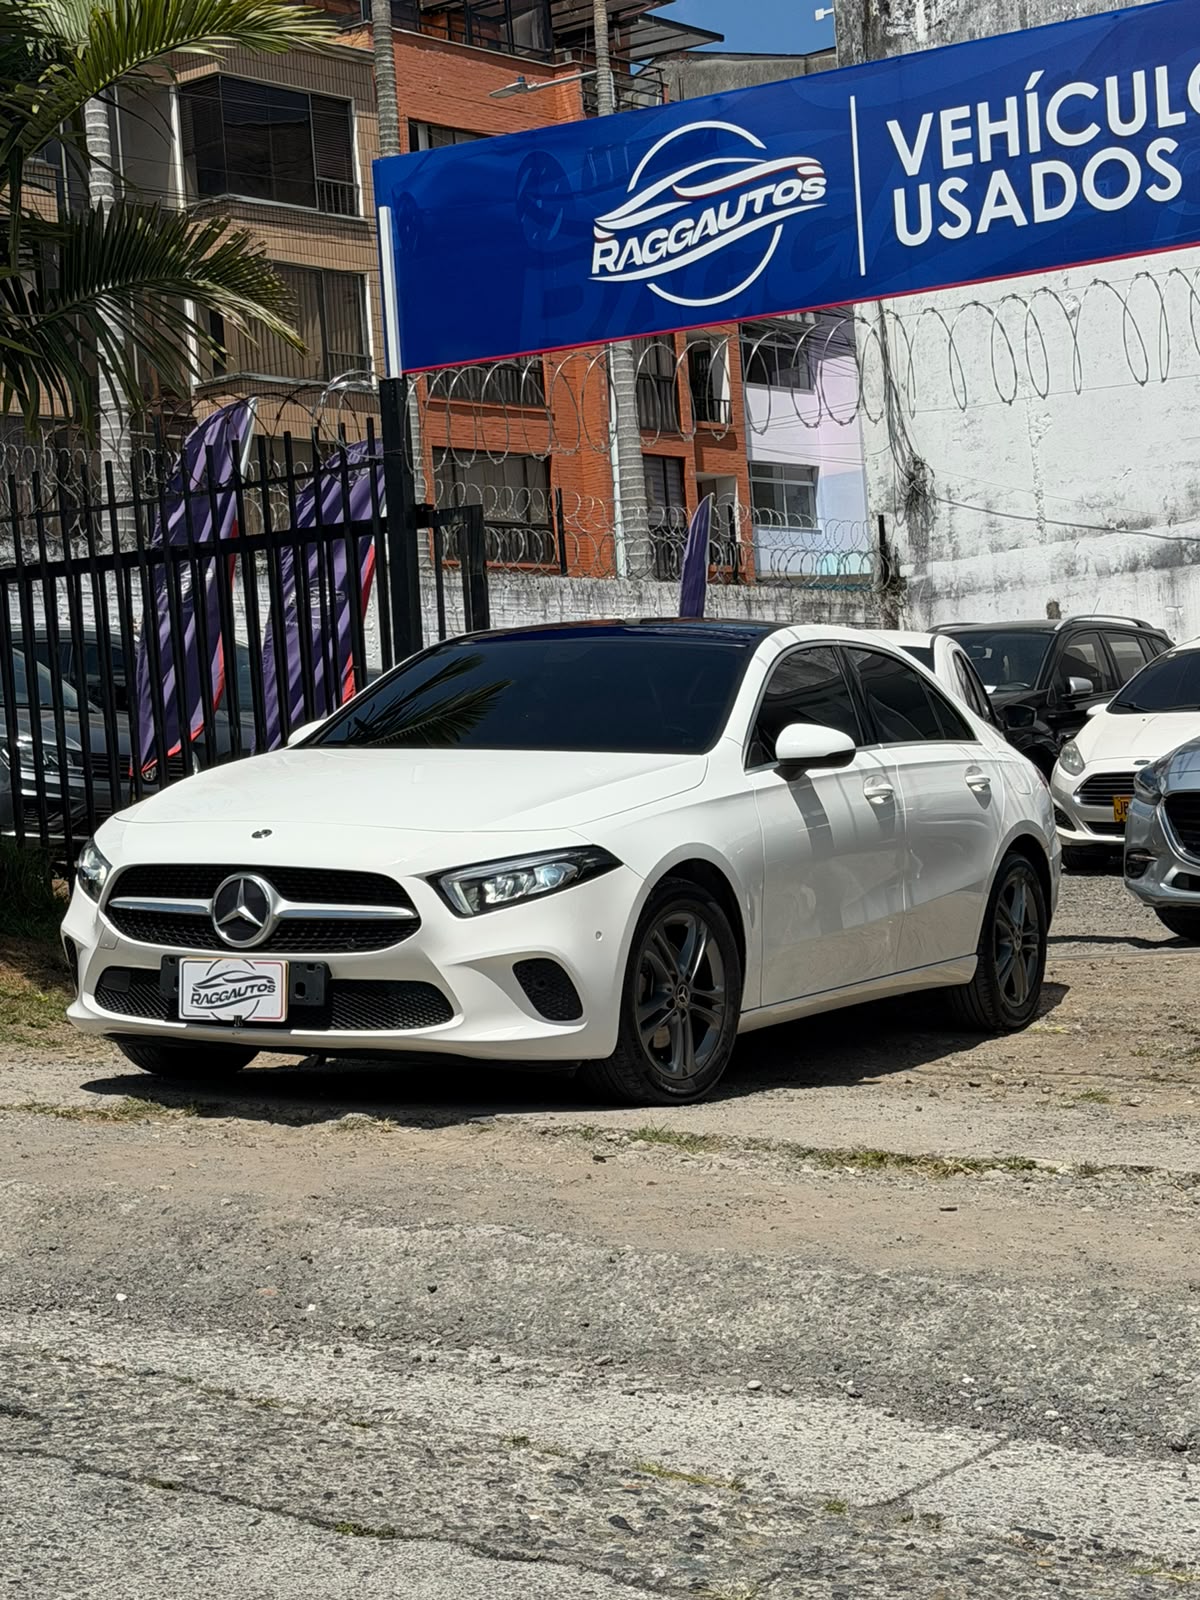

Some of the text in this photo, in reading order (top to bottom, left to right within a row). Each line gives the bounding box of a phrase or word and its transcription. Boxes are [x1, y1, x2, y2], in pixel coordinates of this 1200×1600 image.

[886, 62, 1200, 176] VEHÍCUL
[592, 177, 827, 274] RAGGAUTOS
[893, 137, 1183, 246] USADOS
[191, 983, 276, 1005] RAGGAUTOS
